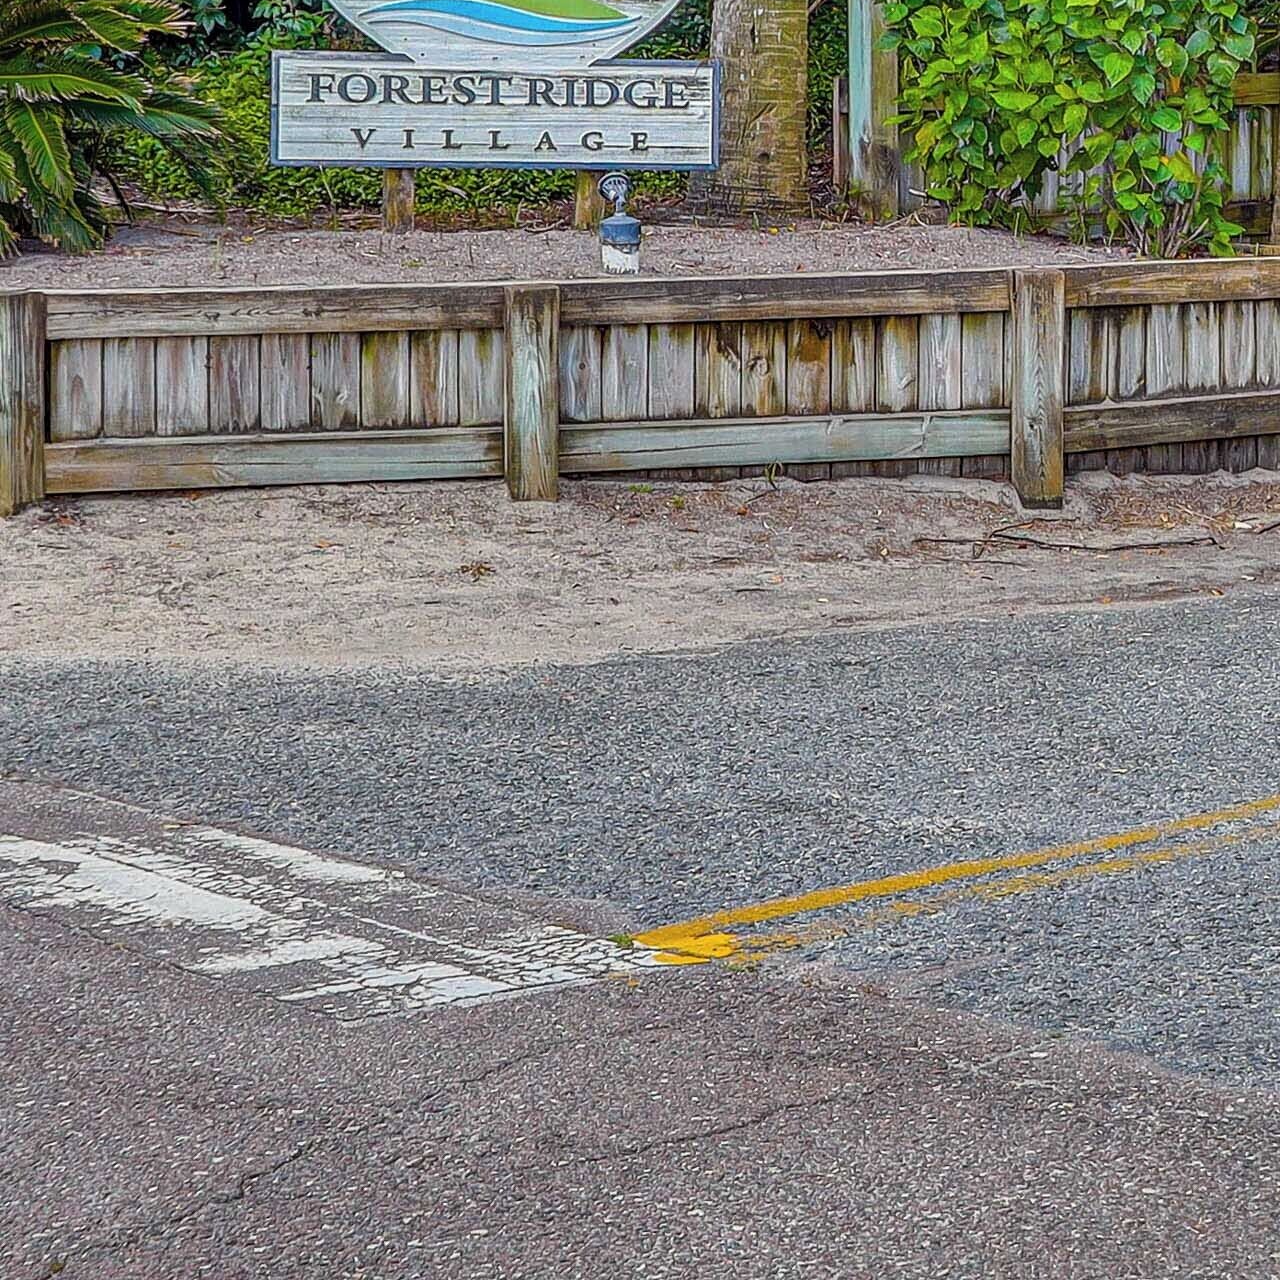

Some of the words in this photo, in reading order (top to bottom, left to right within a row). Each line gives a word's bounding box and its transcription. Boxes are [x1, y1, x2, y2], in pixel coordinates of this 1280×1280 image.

[305, 72, 513, 106] FOREST
[526, 76, 691, 110] RIDGE
[350, 127, 650, 152] VILLAGE
